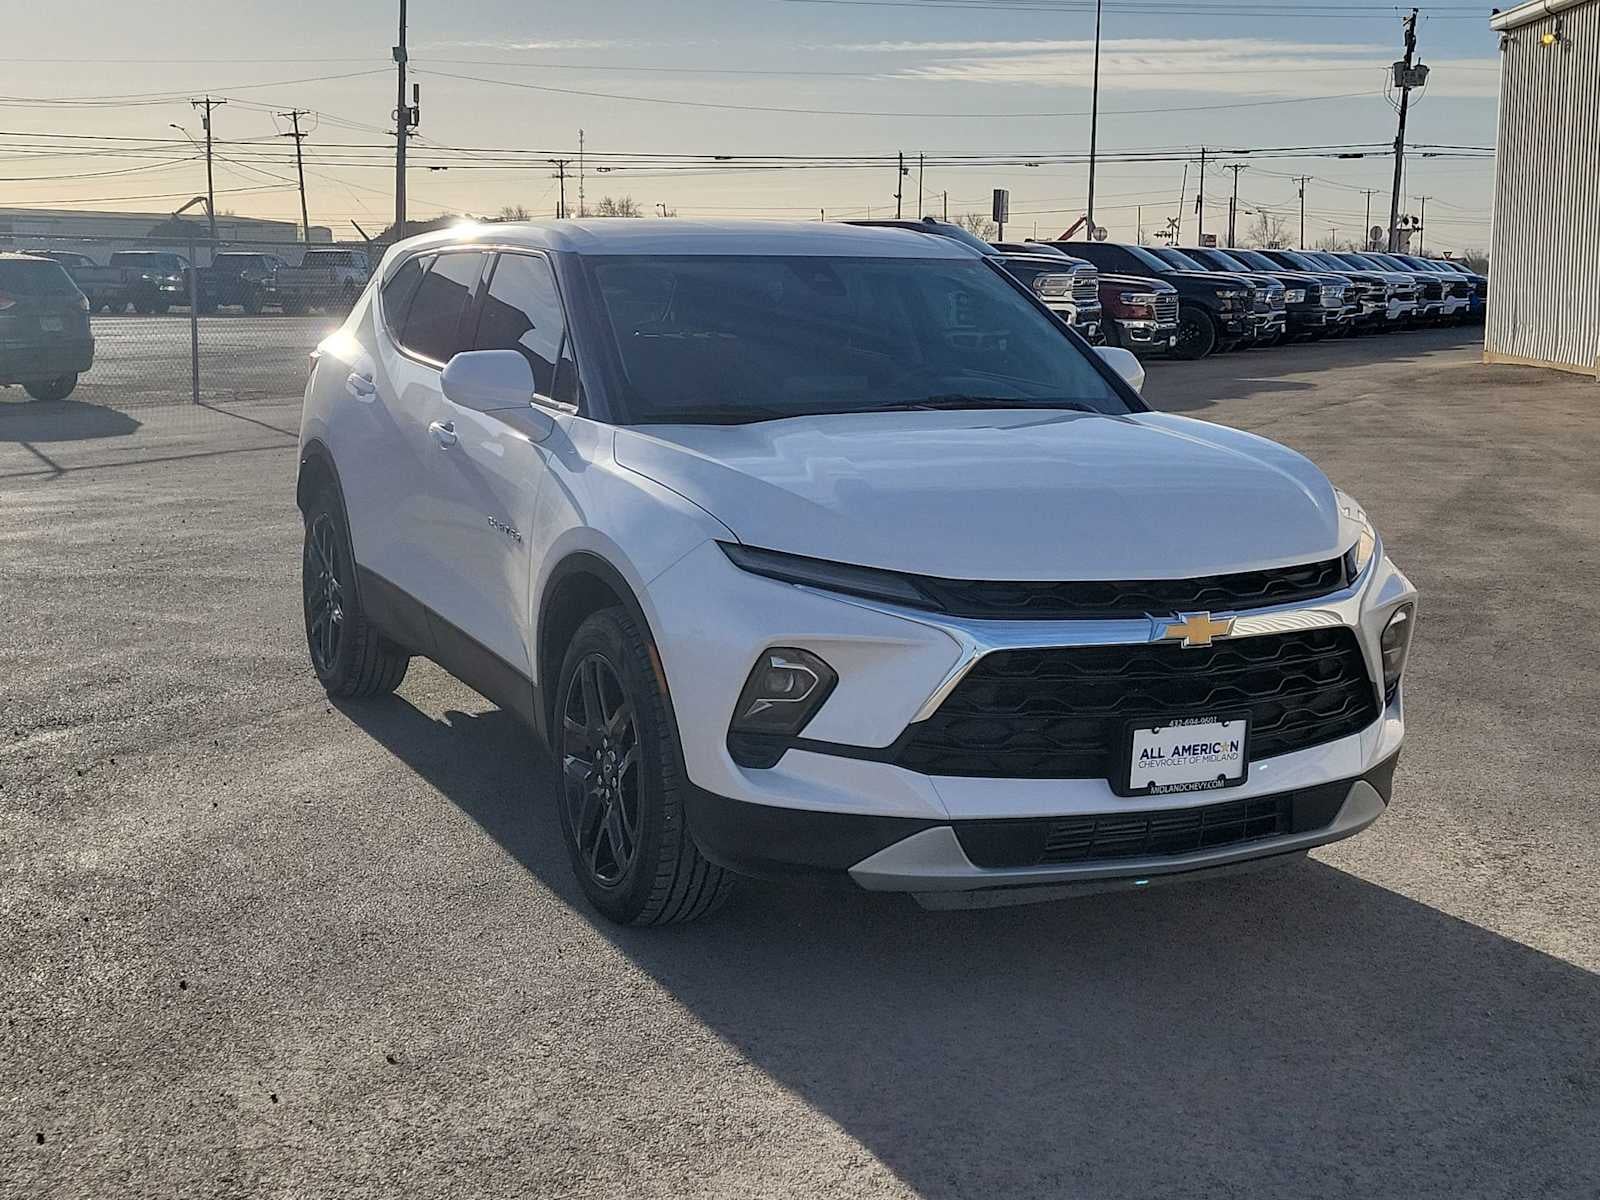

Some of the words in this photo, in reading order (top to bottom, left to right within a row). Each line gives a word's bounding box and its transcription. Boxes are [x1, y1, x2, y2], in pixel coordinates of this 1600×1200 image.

[1138, 758, 1187, 768] CHEVROLET
[1203, 753, 1239, 762] MIDLAND
[1140, 747, 1164, 760] ALL
[1150, 779, 1225, 794] MIDLANDCHEVY.COM
